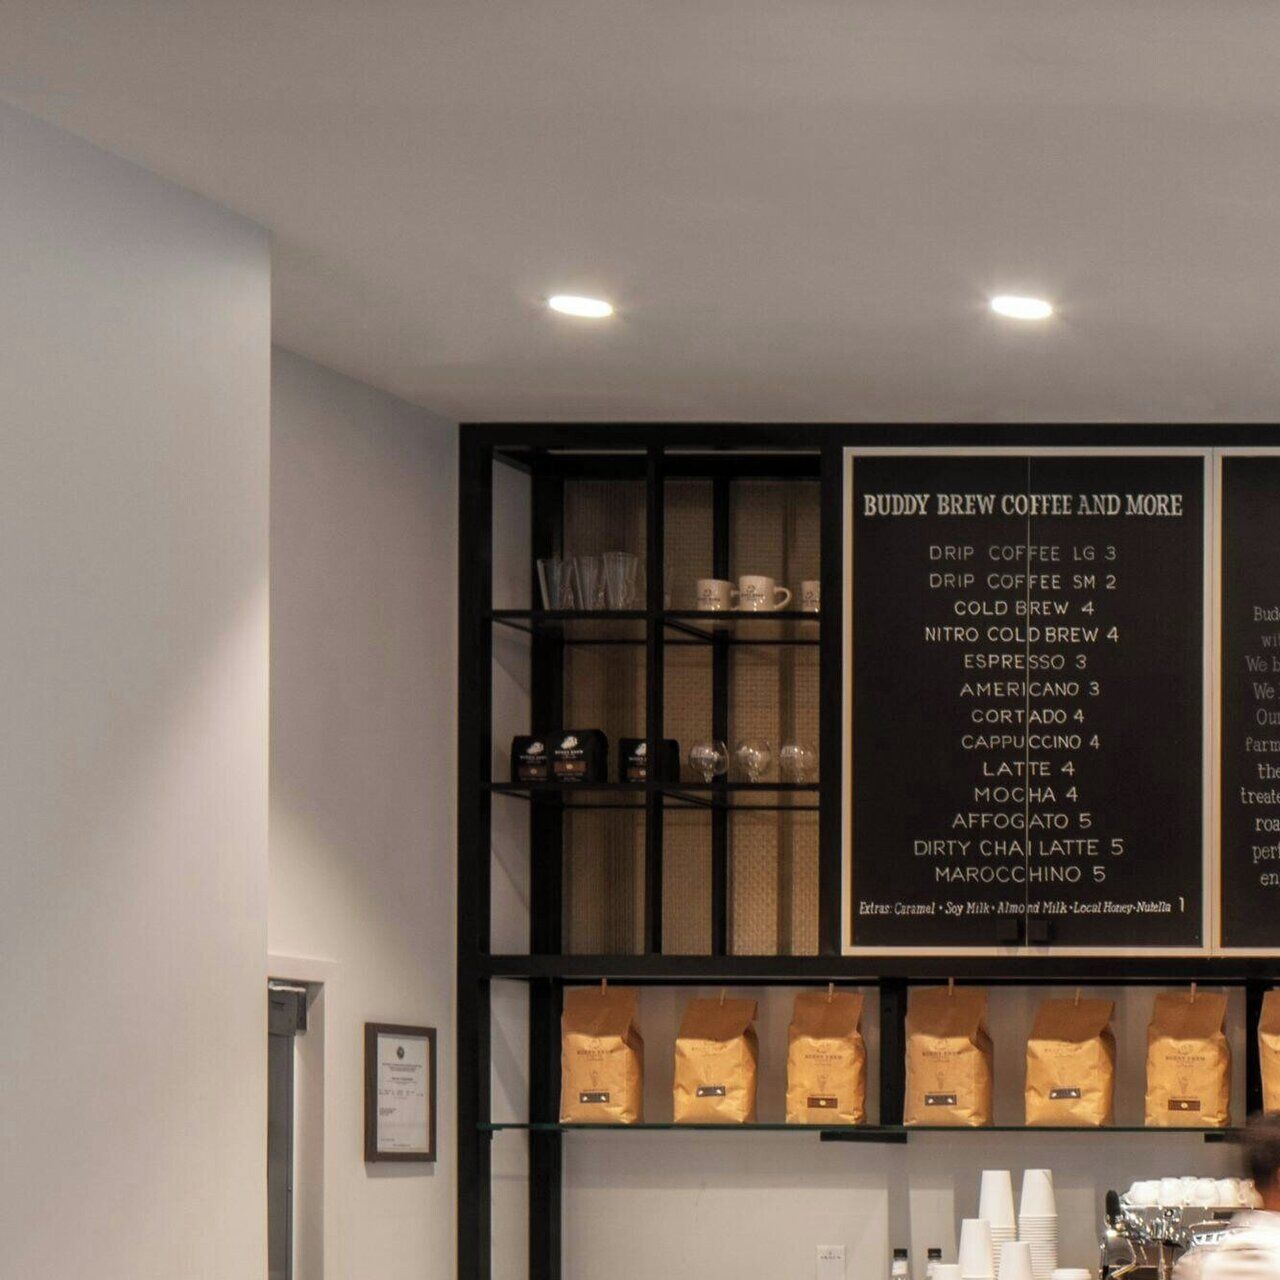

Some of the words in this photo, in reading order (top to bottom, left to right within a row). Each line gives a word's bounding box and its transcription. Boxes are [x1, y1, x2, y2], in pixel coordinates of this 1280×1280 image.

[864, 494, 929, 516] BUDDY
[938, 494, 996, 516] BREW
[1002, 494, 1072, 516] COFFEE
[1078, 494, 1121, 516] AND
[1125, 494, 1182, 516] MORE
[929, 546, 974, 561] DRIP
[989, 546, 1060, 561] COFFEE
[1073, 546, 1095, 561] LG
[1105, 546, 1116, 561] 3
[929, 574, 974, 589] DRIP
[988, 574, 1061, 589] COFFEE
[1073, 574, 1095, 589] SM
[1106, 574, 1116, 589] 2
[954, 601, 1008, 615] COLD
[1016, 601, 1069, 615] BREW
[1081, 601, 1095, 615] 4
[925, 628, 978, 642] NITRO
[988, 628, 1040, 642] COLD
[1045, 628, 1098, 642] BREW
[1107, 628, 1119, 642] 4
[964, 655, 1065, 669] ESPRESSO
[1076, 655, 1086, 669] 3
[1246, 655, 1268, 672] We
[959, 682, 1079, 696] AMERICANO
[1089, 682, 1099, 696] 3
[1253, 682, 1275, 700] We
[971, 710, 1066, 723] CORTADO
[1074, 710, 1084, 723] 4
[961, 736, 1081, 749] CAPPUCCINO
[1089, 736, 1100, 749] 4
[983, 762, 1051, 776] LATTE
[1061, 762, 1075, 776] 4
[974, 788, 1056, 802] MOCHA
[1066, 788, 1078, 802] 4
[952, 814, 1069, 829] AFFOGATO
[1079, 814, 1092, 829] 5
[914, 840, 972, 856] DIRTY
[980, 840, 1032, 856] CHAI
[1039, 840, 1098, 856] LATTE
[1111, 840, 1124, 856] 5
[936, 867, 1081, 882] MAROCCHINO
[1093, 867, 1106, 882] 5
[895, 902, 935, 914] Caramel
[945, 902, 963, 916] Soy
[997, 902, 1039, 914] Almond
